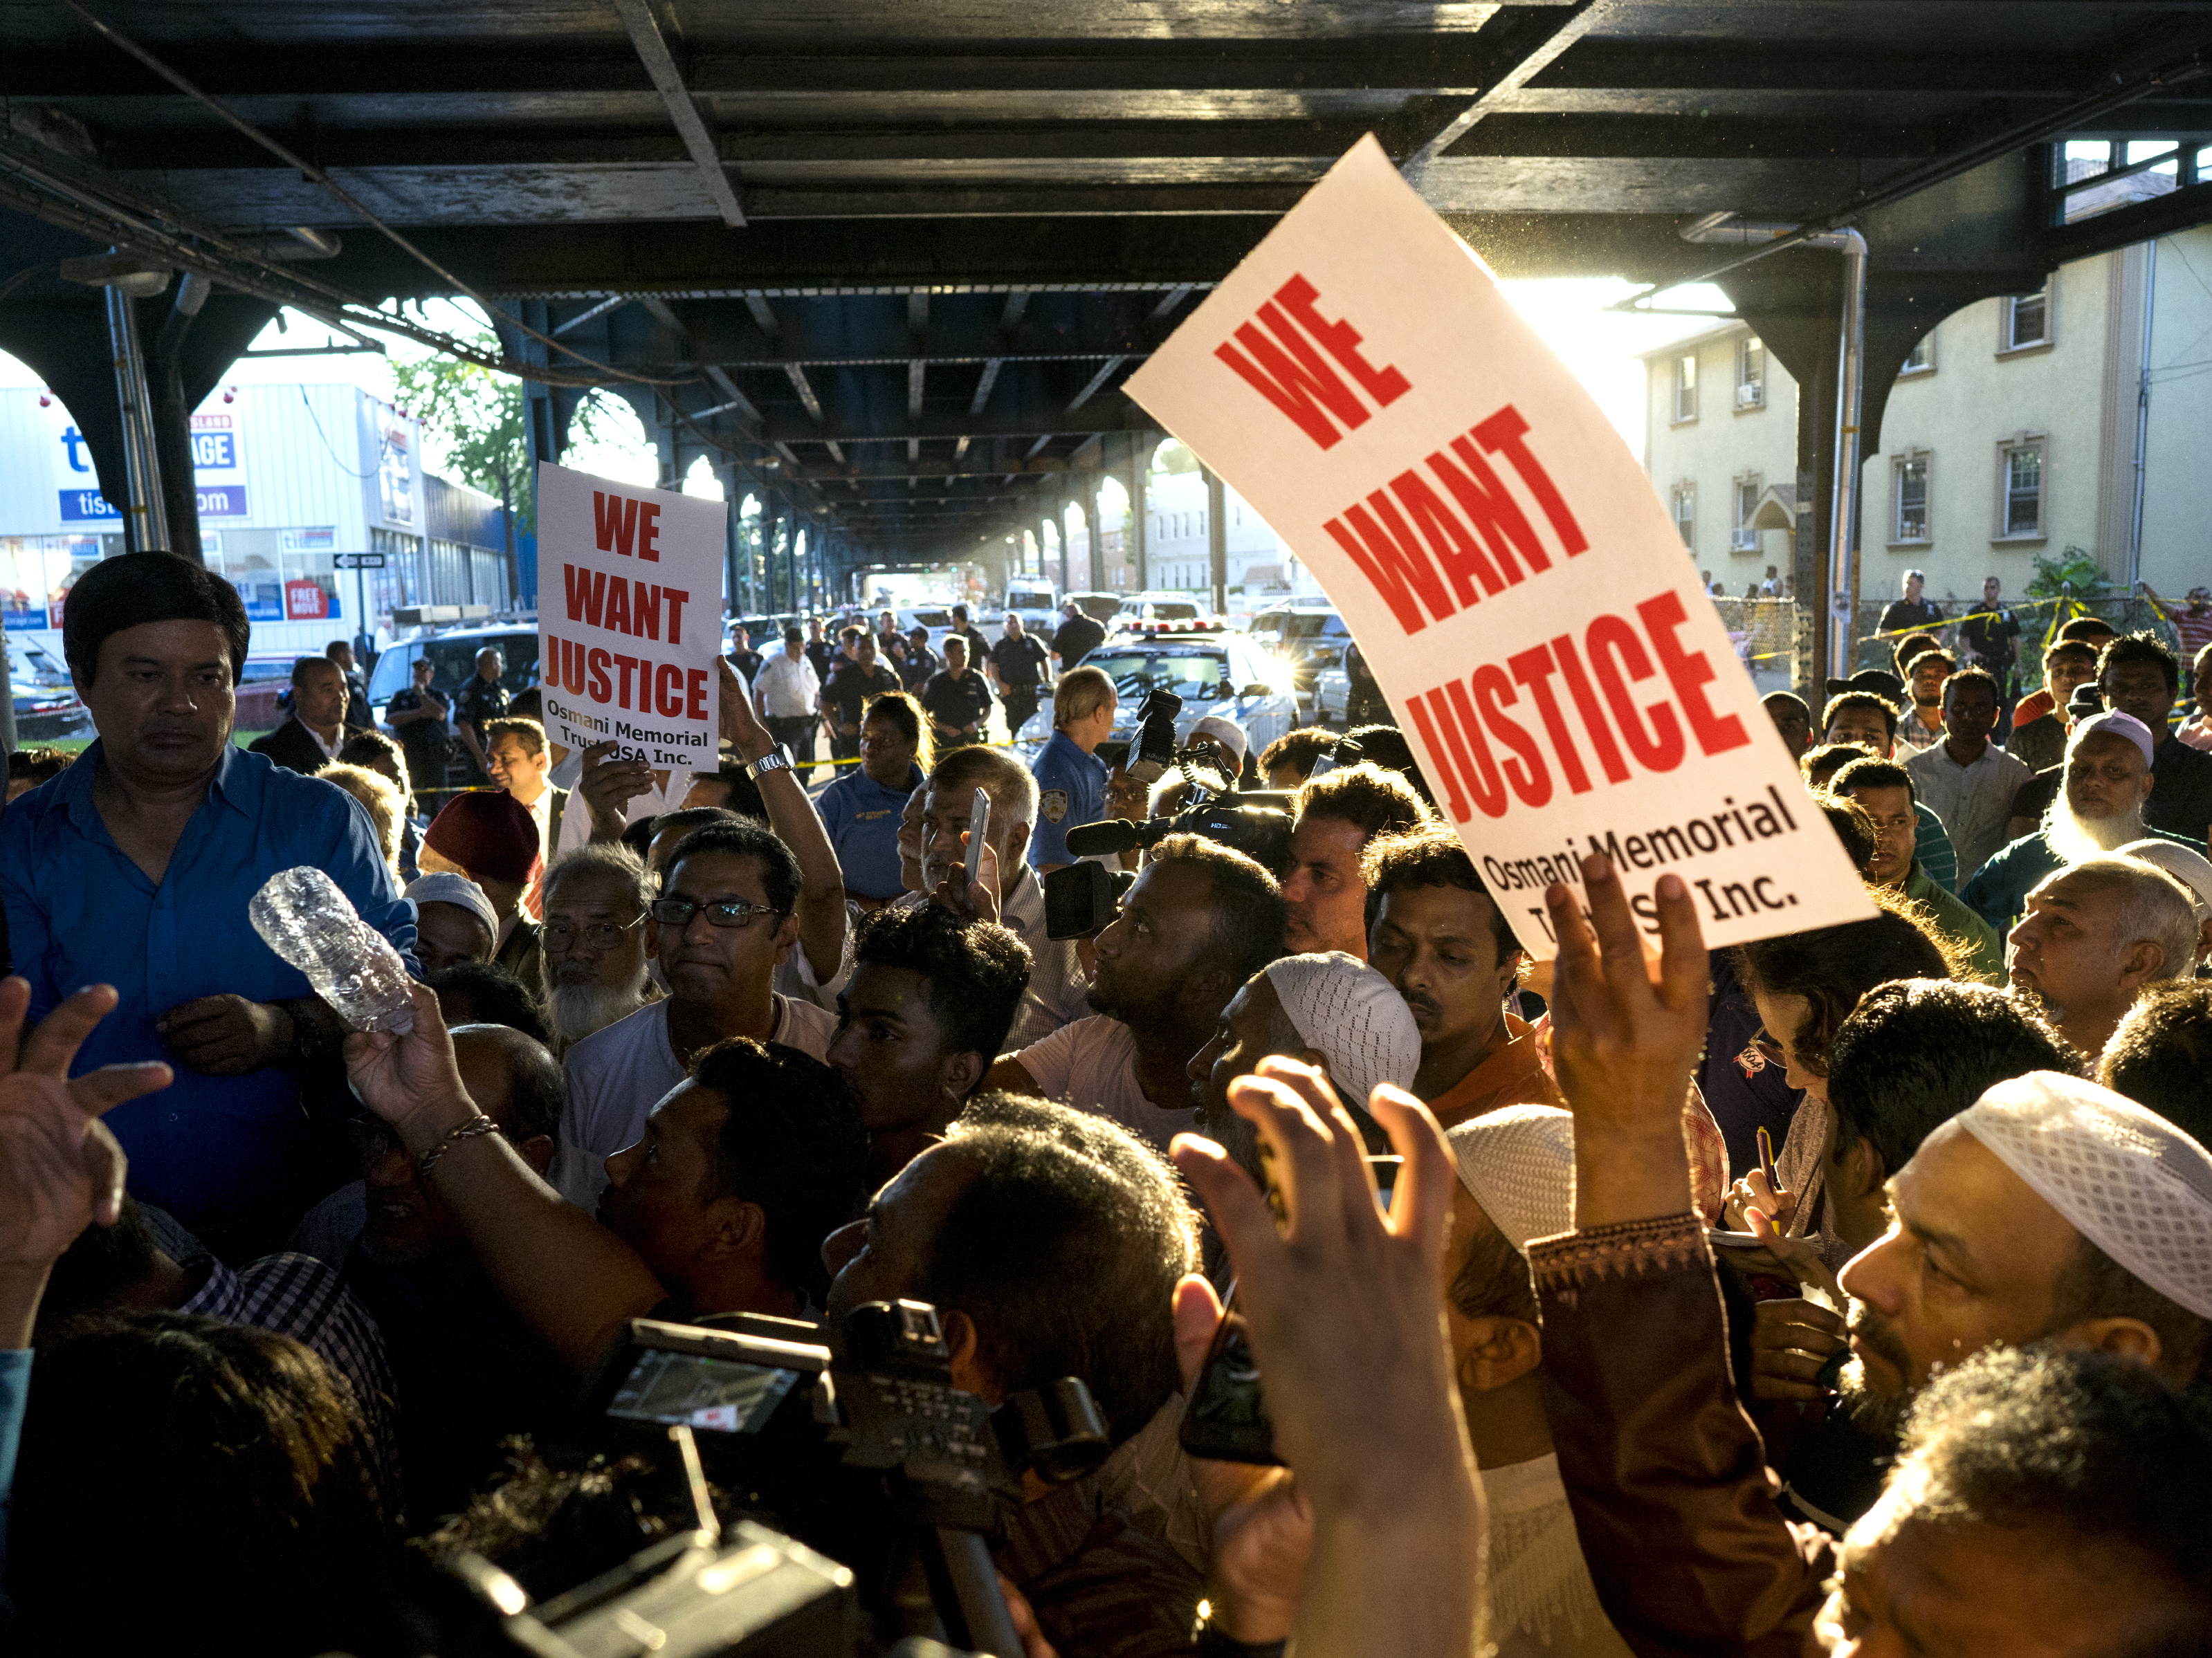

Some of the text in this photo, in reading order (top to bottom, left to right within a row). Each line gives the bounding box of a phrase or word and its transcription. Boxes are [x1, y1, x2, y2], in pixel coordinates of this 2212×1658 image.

[1214, 273, 1413, 451] WE
[594, 490, 661, 562] WE
[1322, 404, 1590, 636] WANT
[291, 588, 319, 602] FREE
[564, 563, 689, 645] WANT
[545, 634, 708, 721] JUSTICE
[1405, 589, 1752, 825] JUSTICE
[547, 699, 708, 747] Osmani Memorial
[654, 749, 692, 765] Inc.
[1483, 784, 1799, 891] Osmani Memorial
[1694, 876, 1799, 921] Inc.
